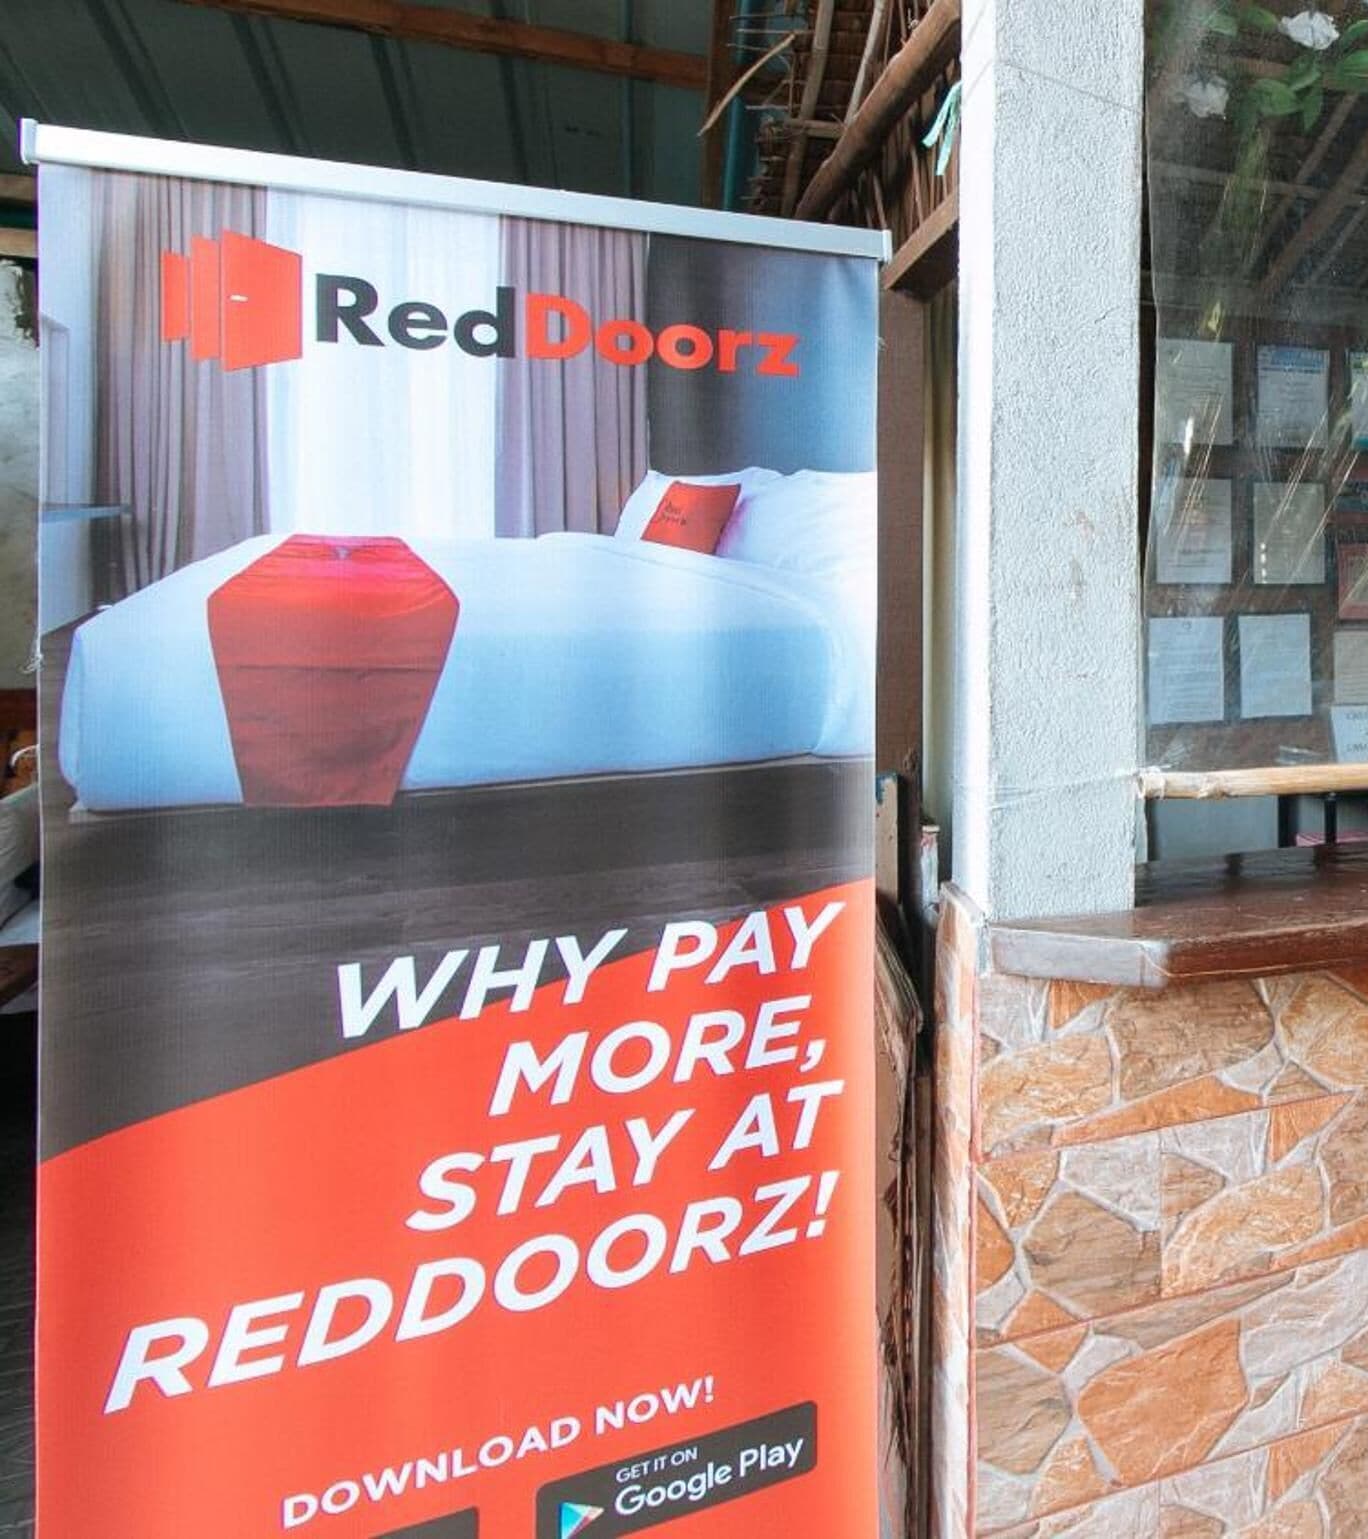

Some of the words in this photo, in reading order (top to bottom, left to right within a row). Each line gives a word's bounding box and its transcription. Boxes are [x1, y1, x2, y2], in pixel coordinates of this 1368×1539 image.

[315, 272, 800, 378] RedDoorz
[337, 927, 628, 1039] WHY
[647, 901, 846, 993] PAY
[488, 996, 826, 1117] MORE,
[406, 1108, 695, 1232] STAY
[708, 1080, 844, 1171] AT
[103, 1170, 841, 1415] REDDOORZ!
[281, 1416, 581, 1530] DOWNLOAD
[594, 1375, 716, 1437] NOW!
[614, 1462, 733, 1517] Google
[739, 1437, 805, 1480] Play
[615, 1458, 651, 1484] GET
[652, 1453, 668, 1472] IT
[669, 1446, 699, 1468] ON
